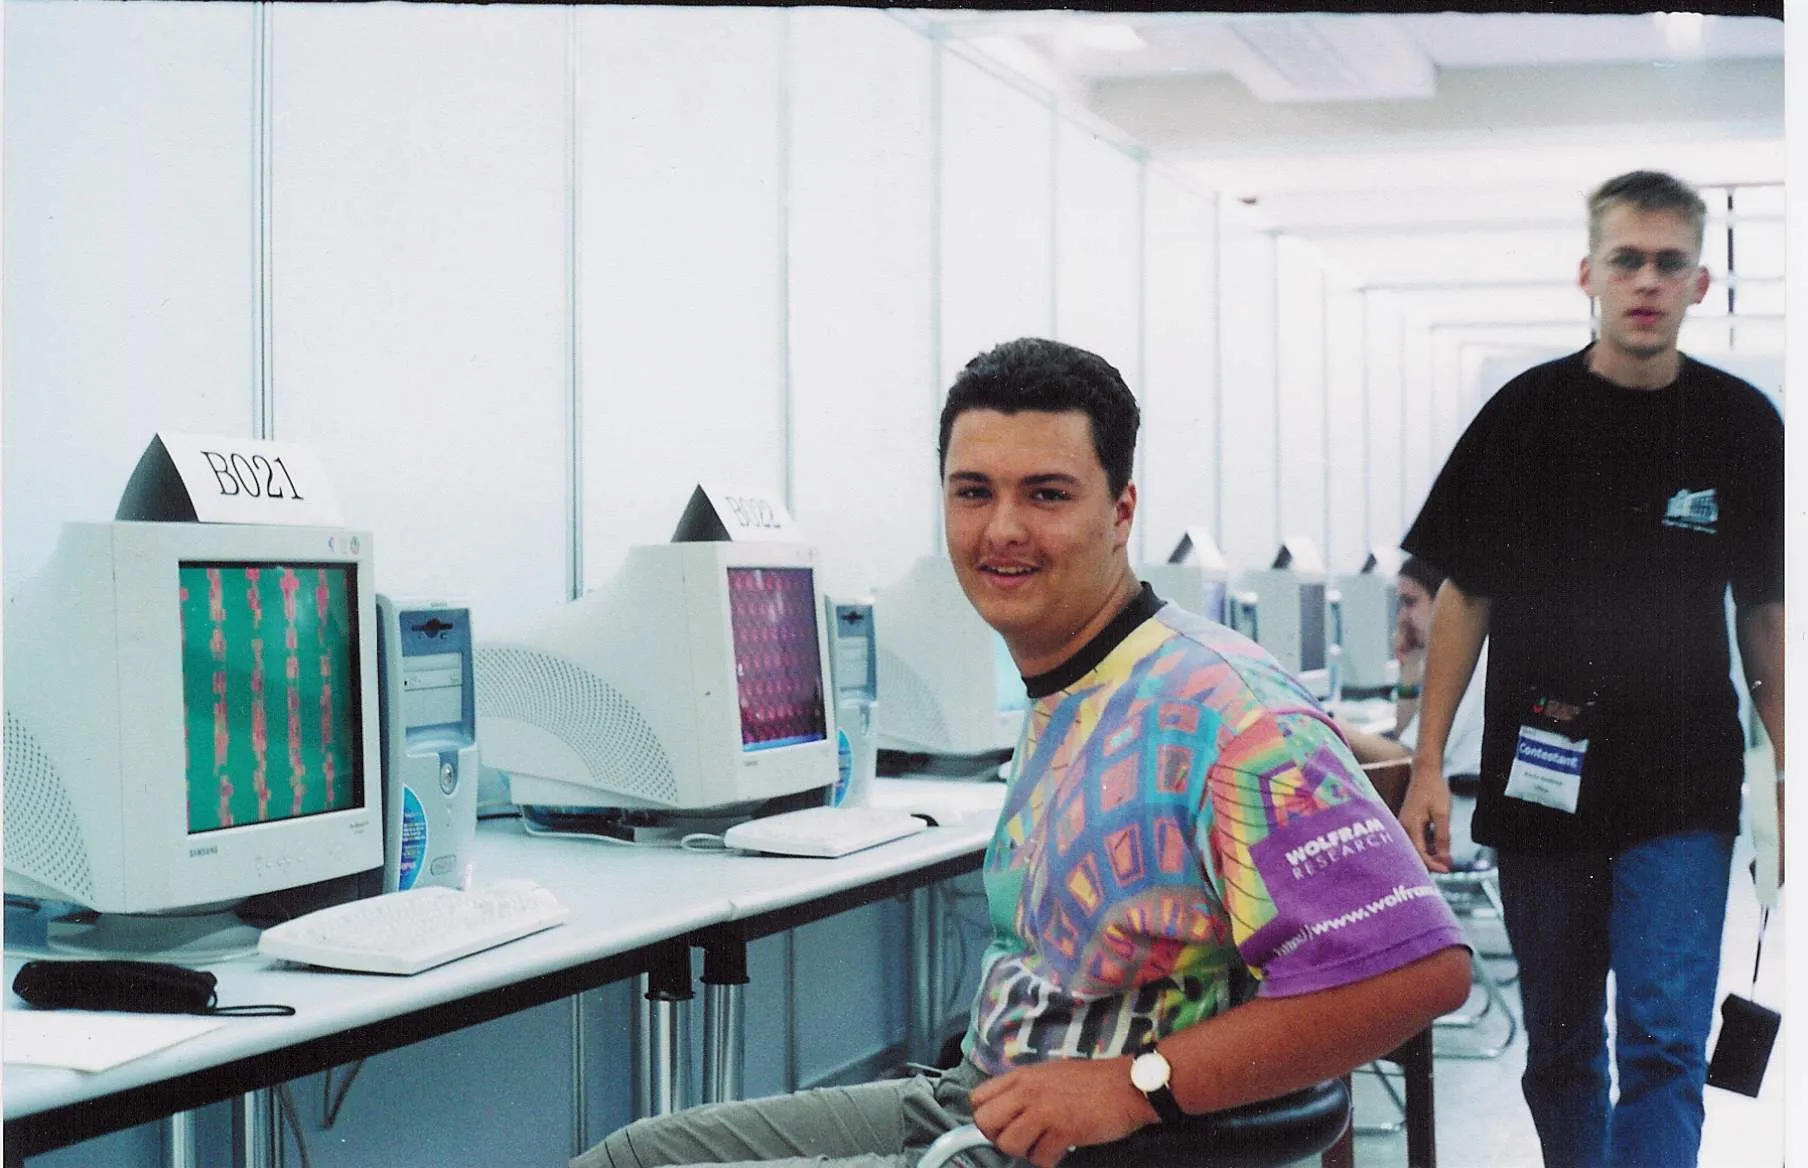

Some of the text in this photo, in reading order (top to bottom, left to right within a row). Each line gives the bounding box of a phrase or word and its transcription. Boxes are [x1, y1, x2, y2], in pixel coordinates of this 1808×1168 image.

[200, 450, 304, 500] B021
[1519, 742, 1579, 769] Contestant
[1285, 816, 1386, 867] WOLFRAM
[1291, 830, 1394, 881] RESEARCH
